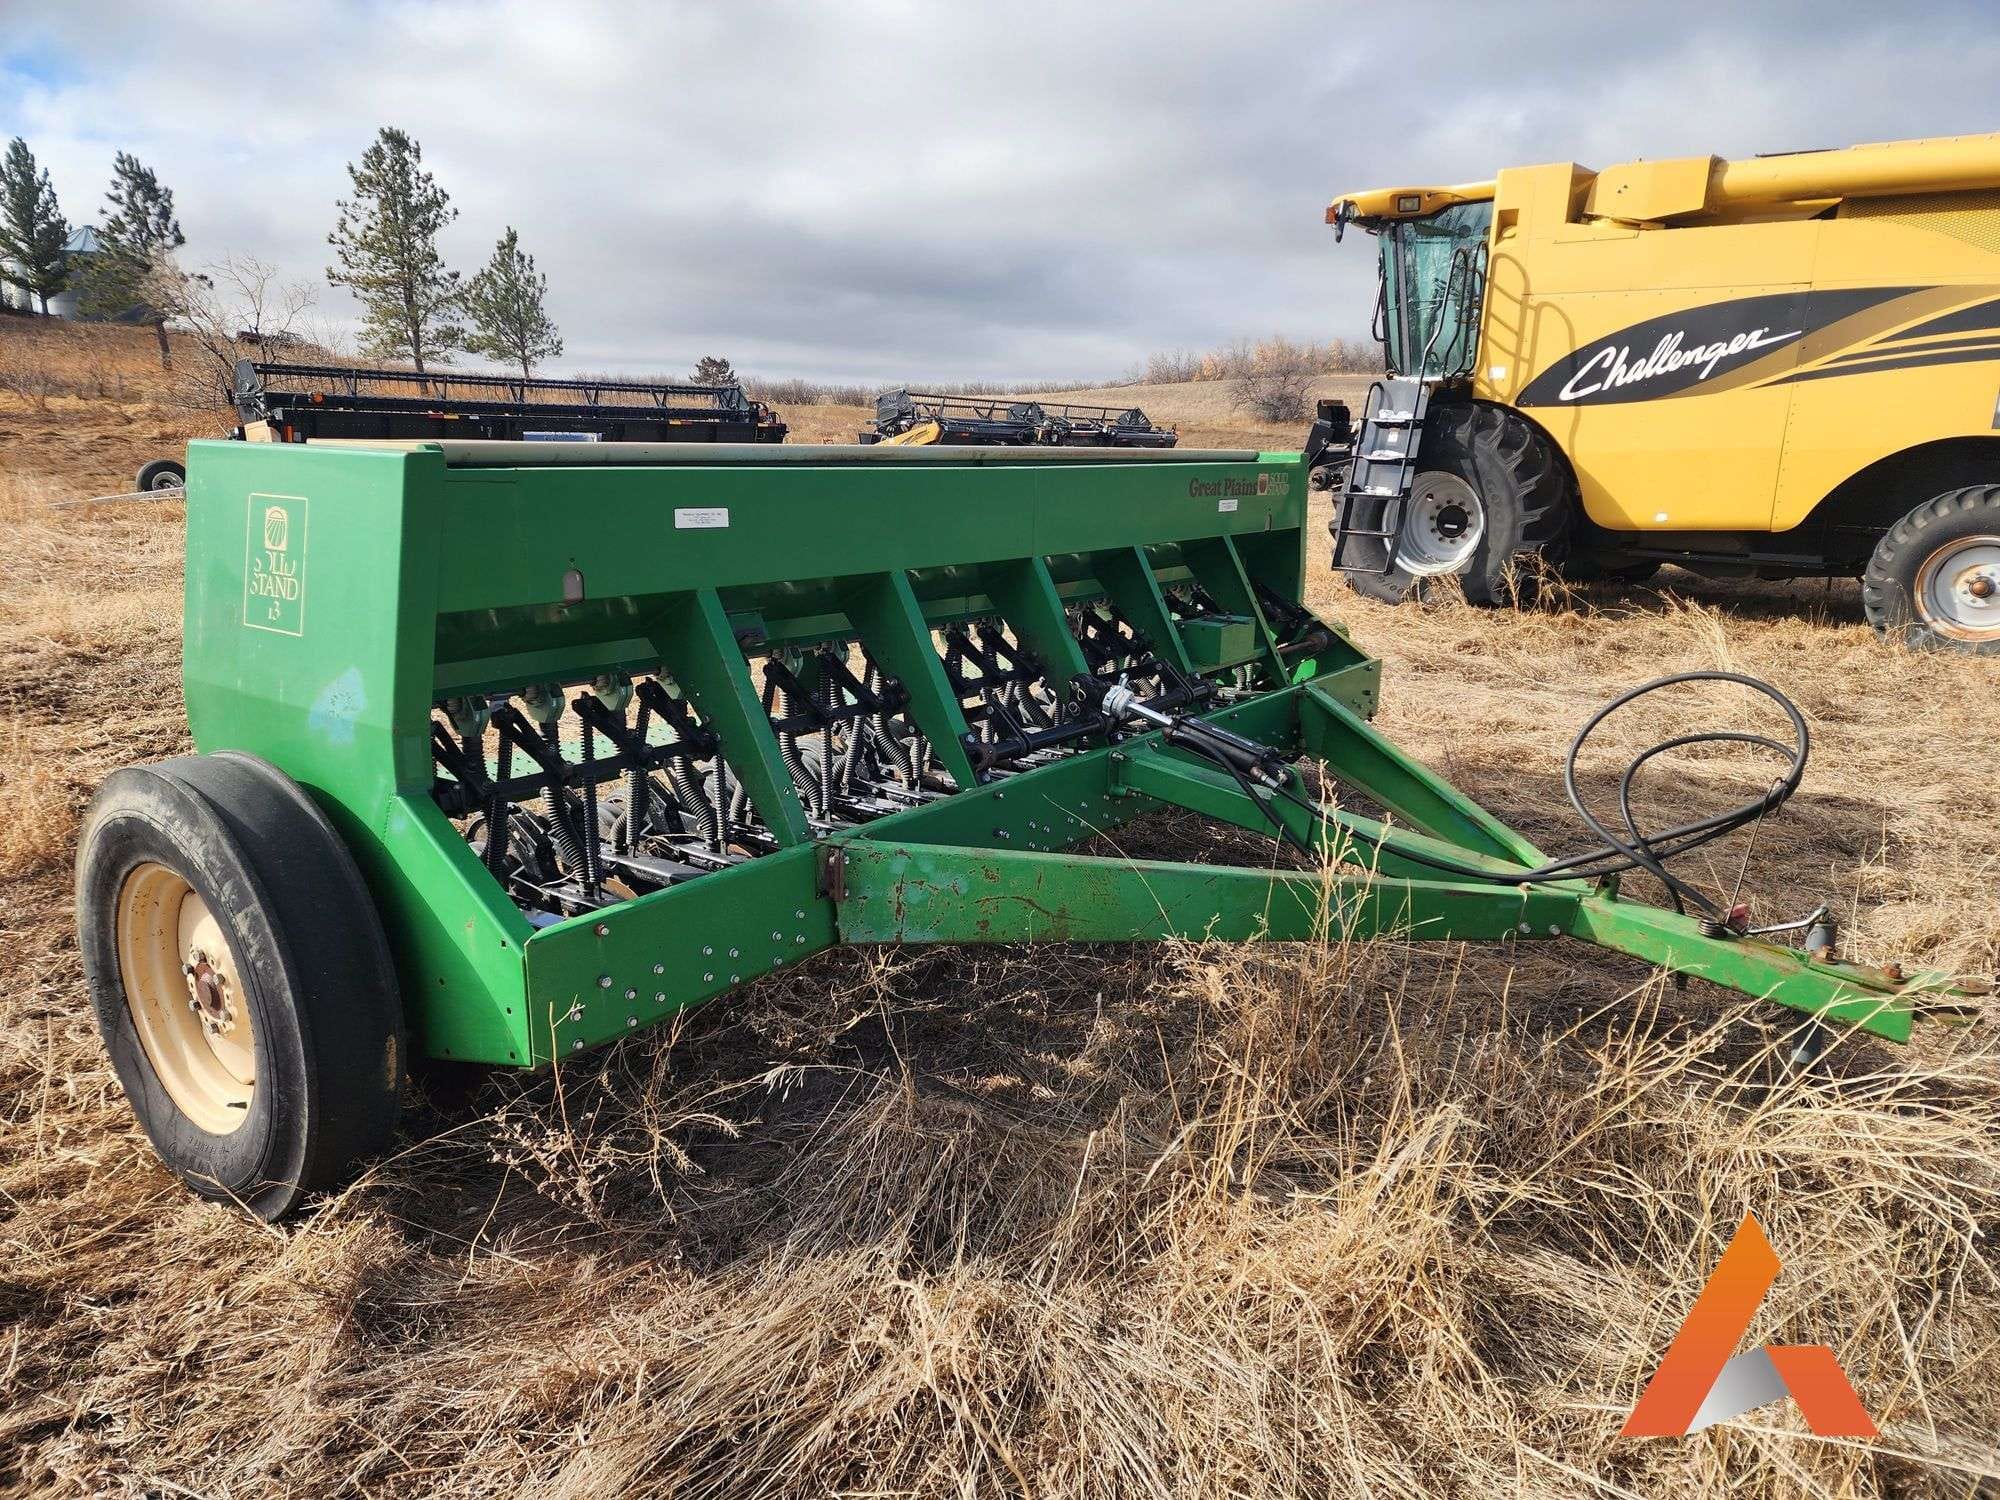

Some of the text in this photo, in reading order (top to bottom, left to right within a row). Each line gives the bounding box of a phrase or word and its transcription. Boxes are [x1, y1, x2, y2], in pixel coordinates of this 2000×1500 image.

[1559, 328, 1802, 401] Challenger
[1189, 477, 1258, 497] Great Plains
[249, 571, 299, 601] STAND
